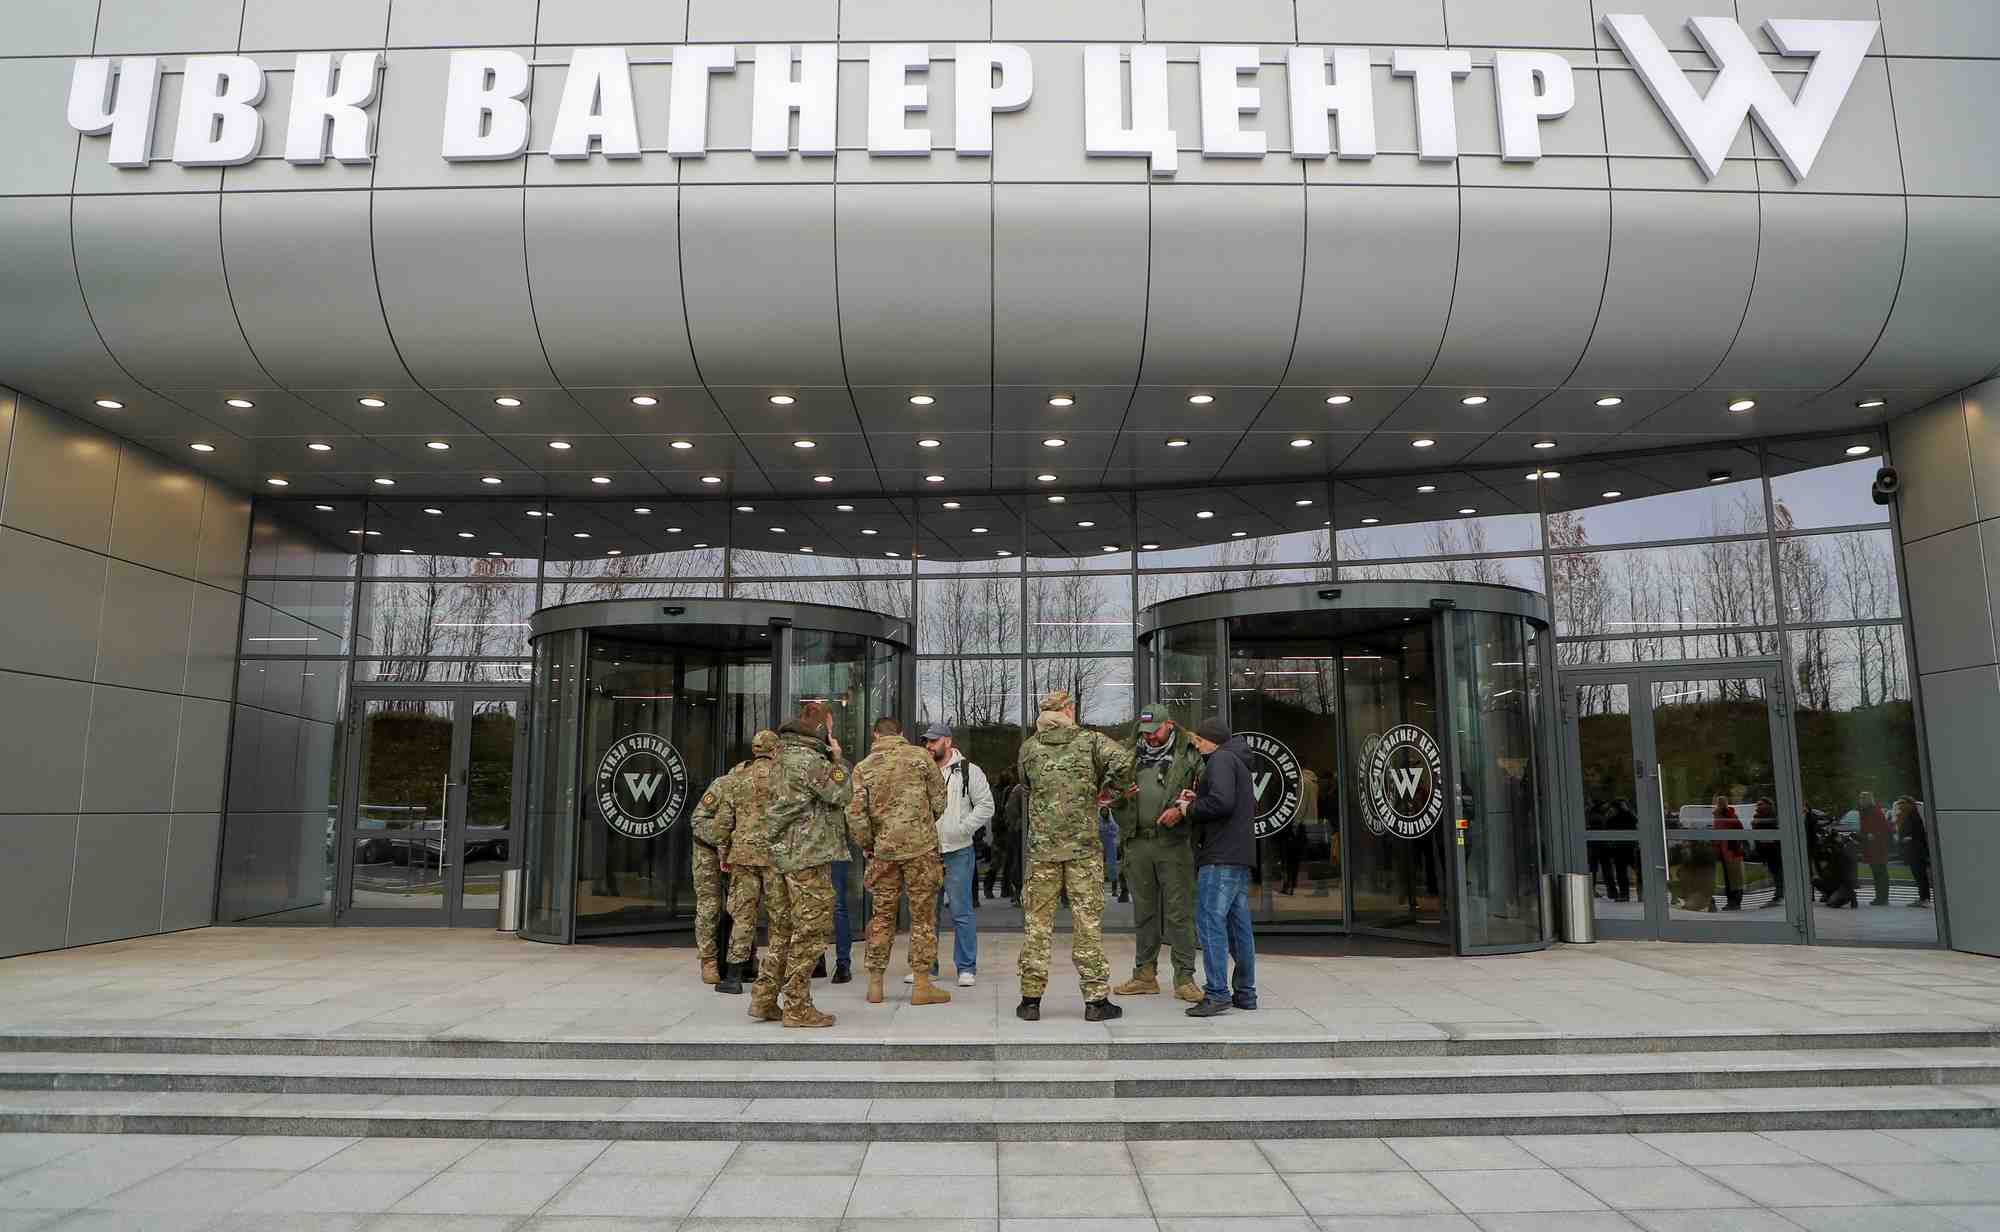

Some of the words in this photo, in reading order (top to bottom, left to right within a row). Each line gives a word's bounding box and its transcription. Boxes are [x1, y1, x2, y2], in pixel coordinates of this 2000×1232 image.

[67, 53, 380, 168] ЧВК
[442, 44, 1034, 161] ВАГНЕР
[1084, 45, 1575, 176] ЦЕНТР
[1601, 13, 1881, 184] W
[1384, 728, 1418, 752] ВАГНЕР
[614, 815, 655, 835] ВАГНЕР
[656, 793, 682, 828] ЦЕНТР
[1268, 792, 1298, 828] ЦЕНТР
